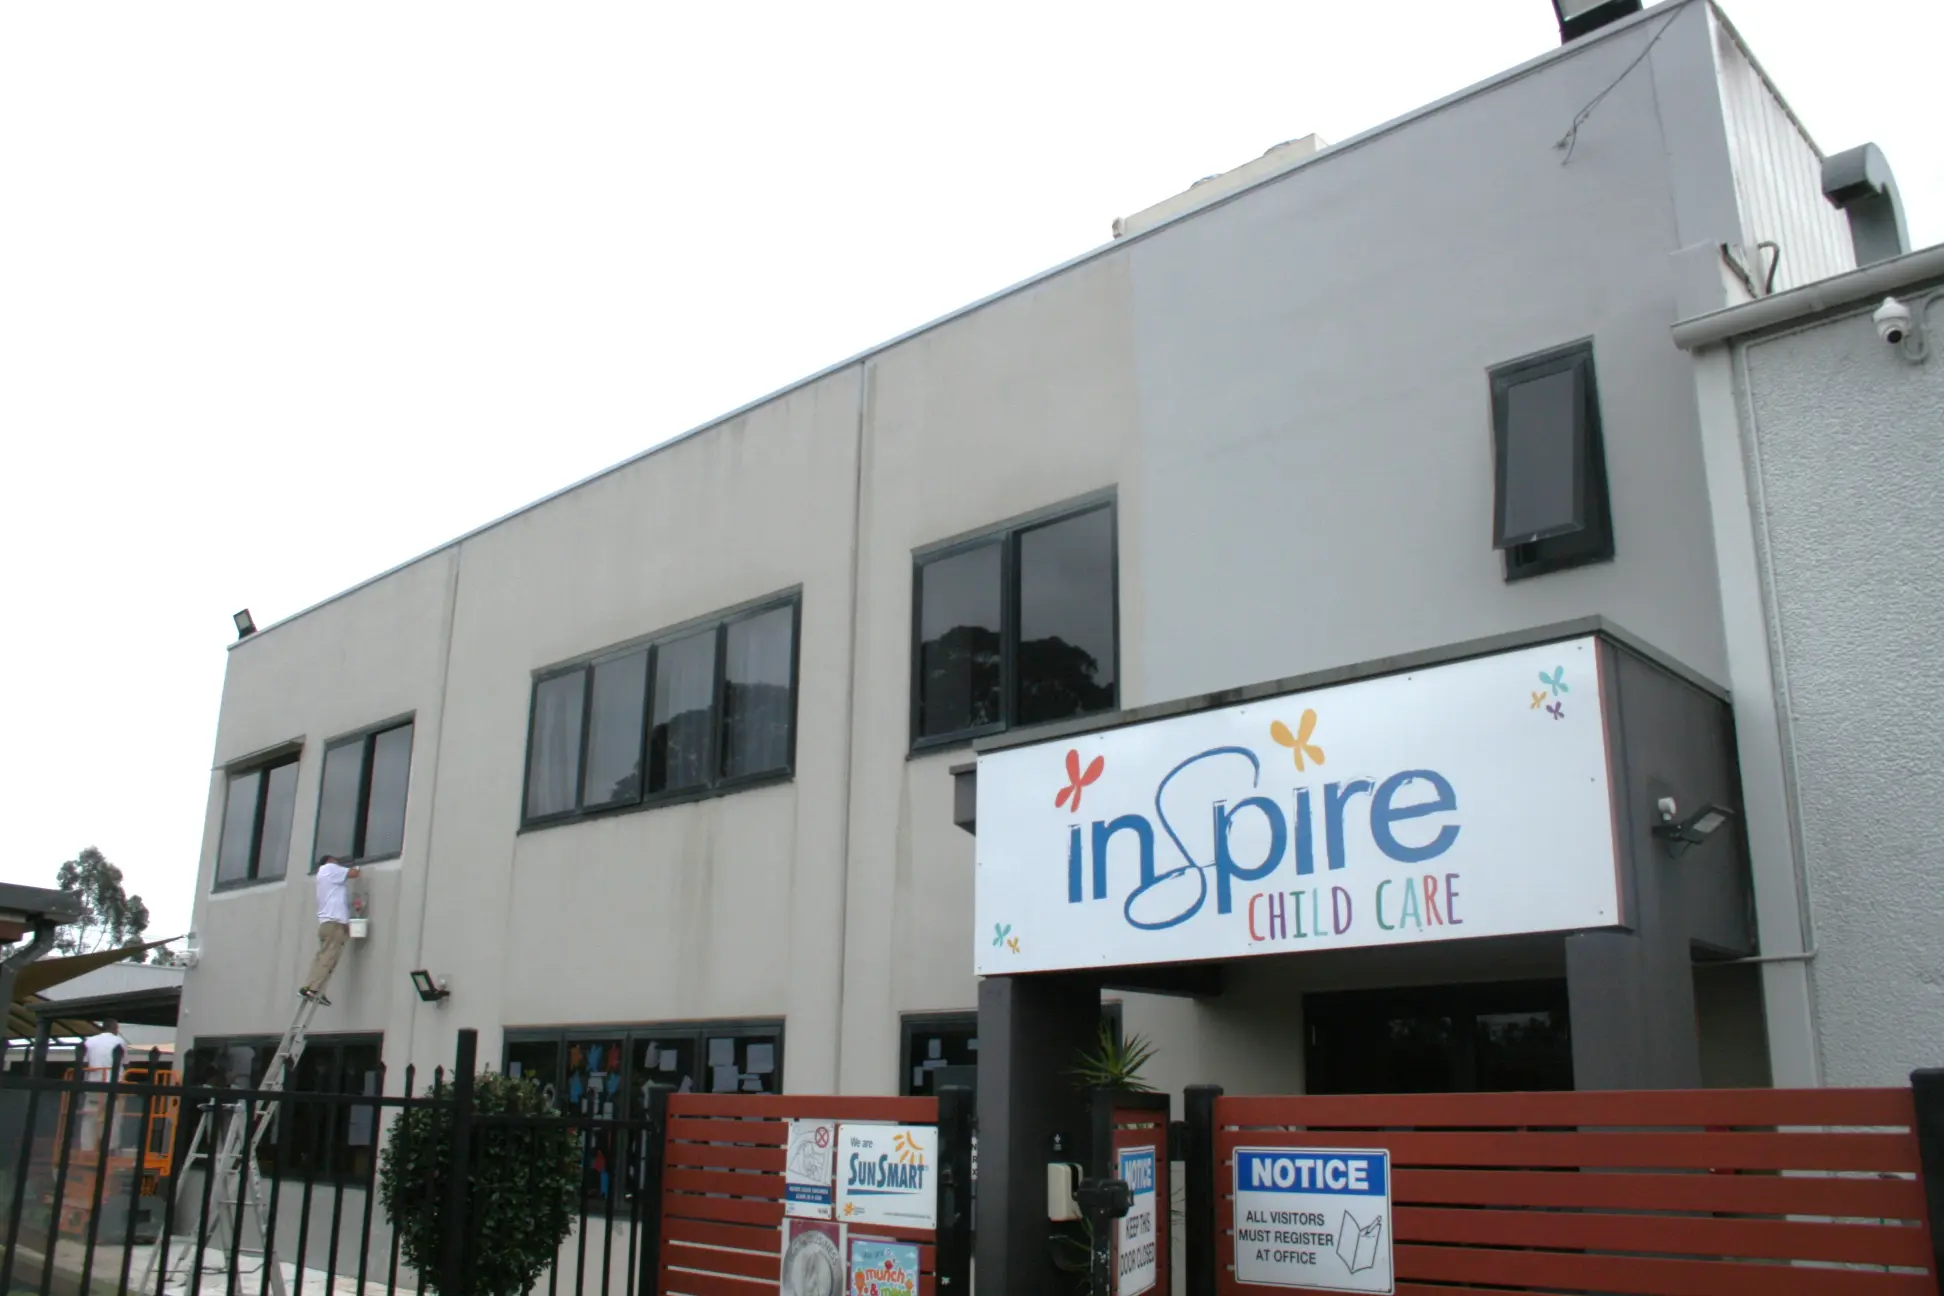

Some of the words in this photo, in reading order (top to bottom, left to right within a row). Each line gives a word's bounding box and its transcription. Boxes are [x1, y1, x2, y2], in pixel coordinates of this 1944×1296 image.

[1248, 885, 1353, 942] CHILD
[1376, 872, 1465, 931] CARE
[850, 1137, 862, 1148] We
[862, 1138, 874, 1149] are
[1125, 1157, 1152, 1191] NOTICE
[1252, 1158, 1369, 1190] NOTICE
[1126, 1214, 1139, 1240] KEEP
[1246, 1210, 1267, 1224] ALL
[1271, 1211, 1325, 1226] VISITORS
[1238, 1230, 1272, 1244] MUST
[1274, 1231, 1334, 1246] REGISTER
[1120, 1248, 1136, 1277] DOOR
[1136, 1241, 1155, 1269] CLOSED
[1256, 1249, 1271, 1262] AT
[1274, 1249, 1316, 1265] OFFICE
[865, 1267, 906, 1285] munch
